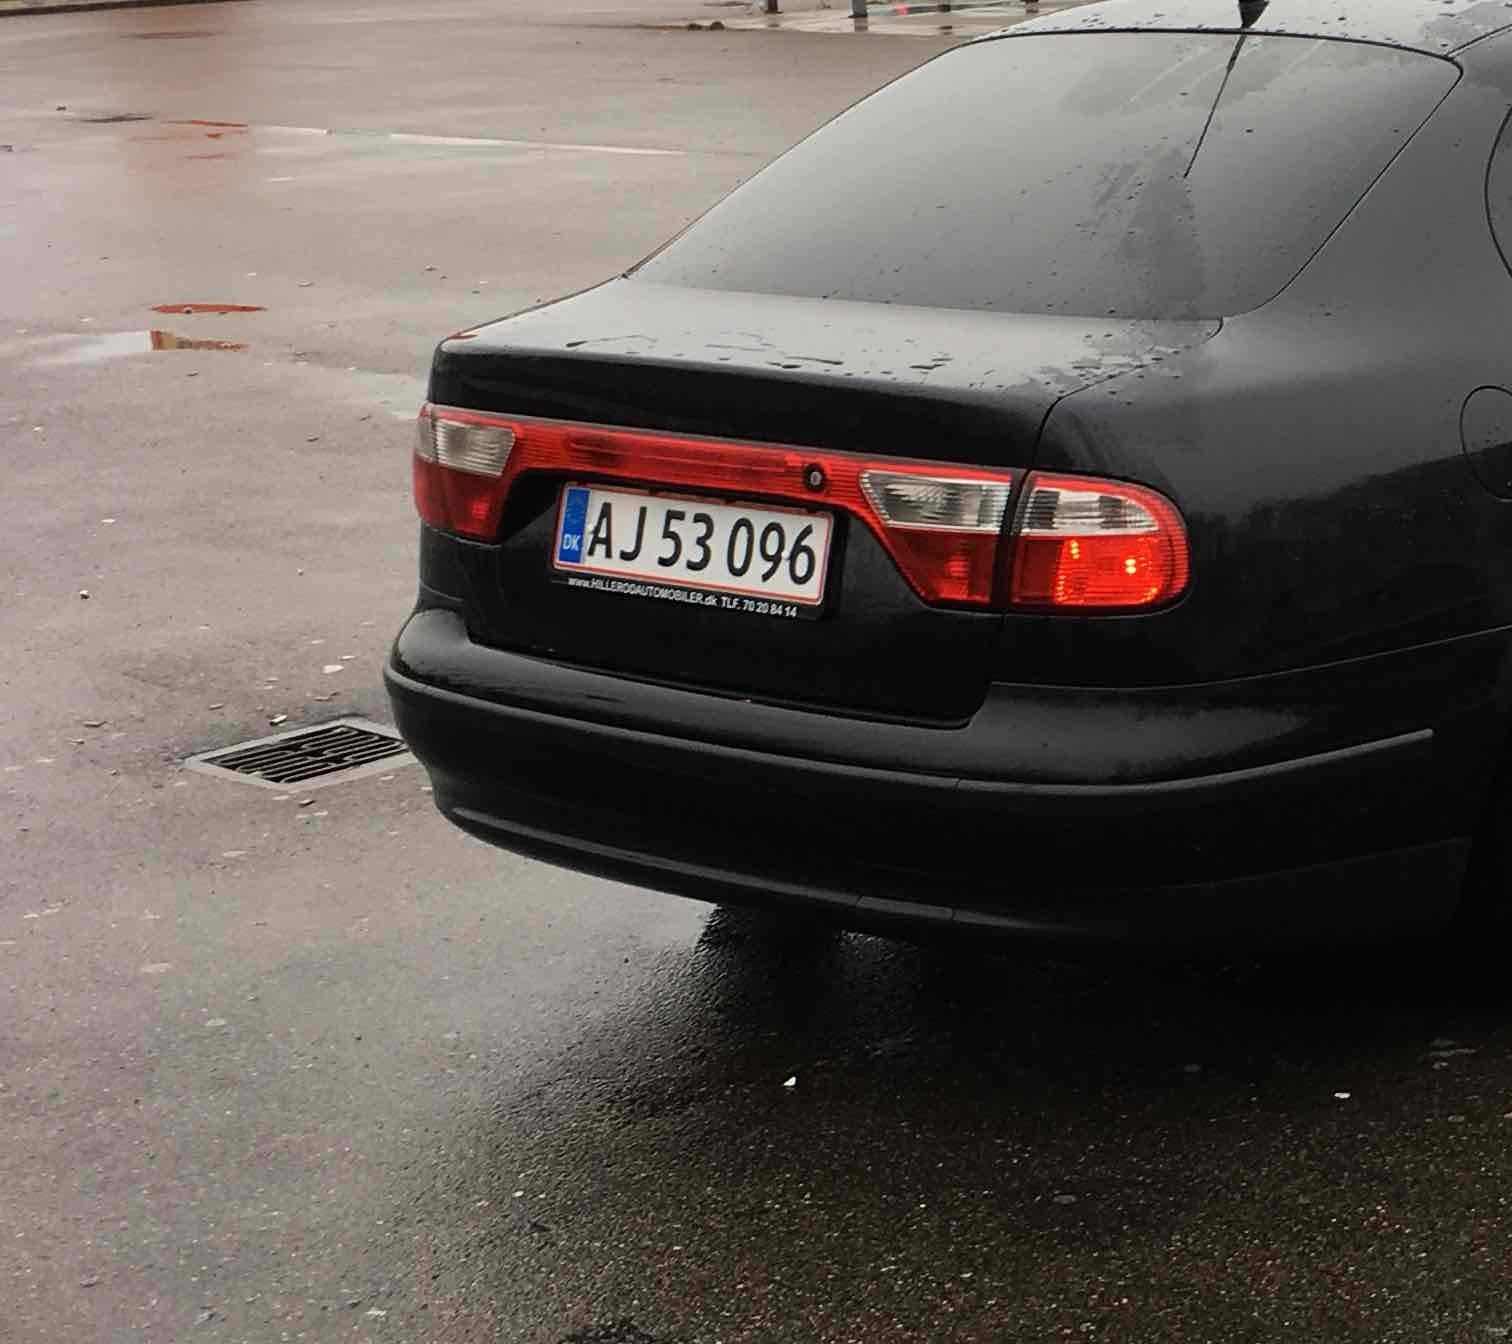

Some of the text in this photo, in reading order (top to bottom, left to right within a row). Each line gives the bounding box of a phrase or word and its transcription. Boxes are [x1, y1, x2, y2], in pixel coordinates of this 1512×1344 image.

[562, 534, 580, 551] DK
[587, 502, 816, 585] AJ 53 096
